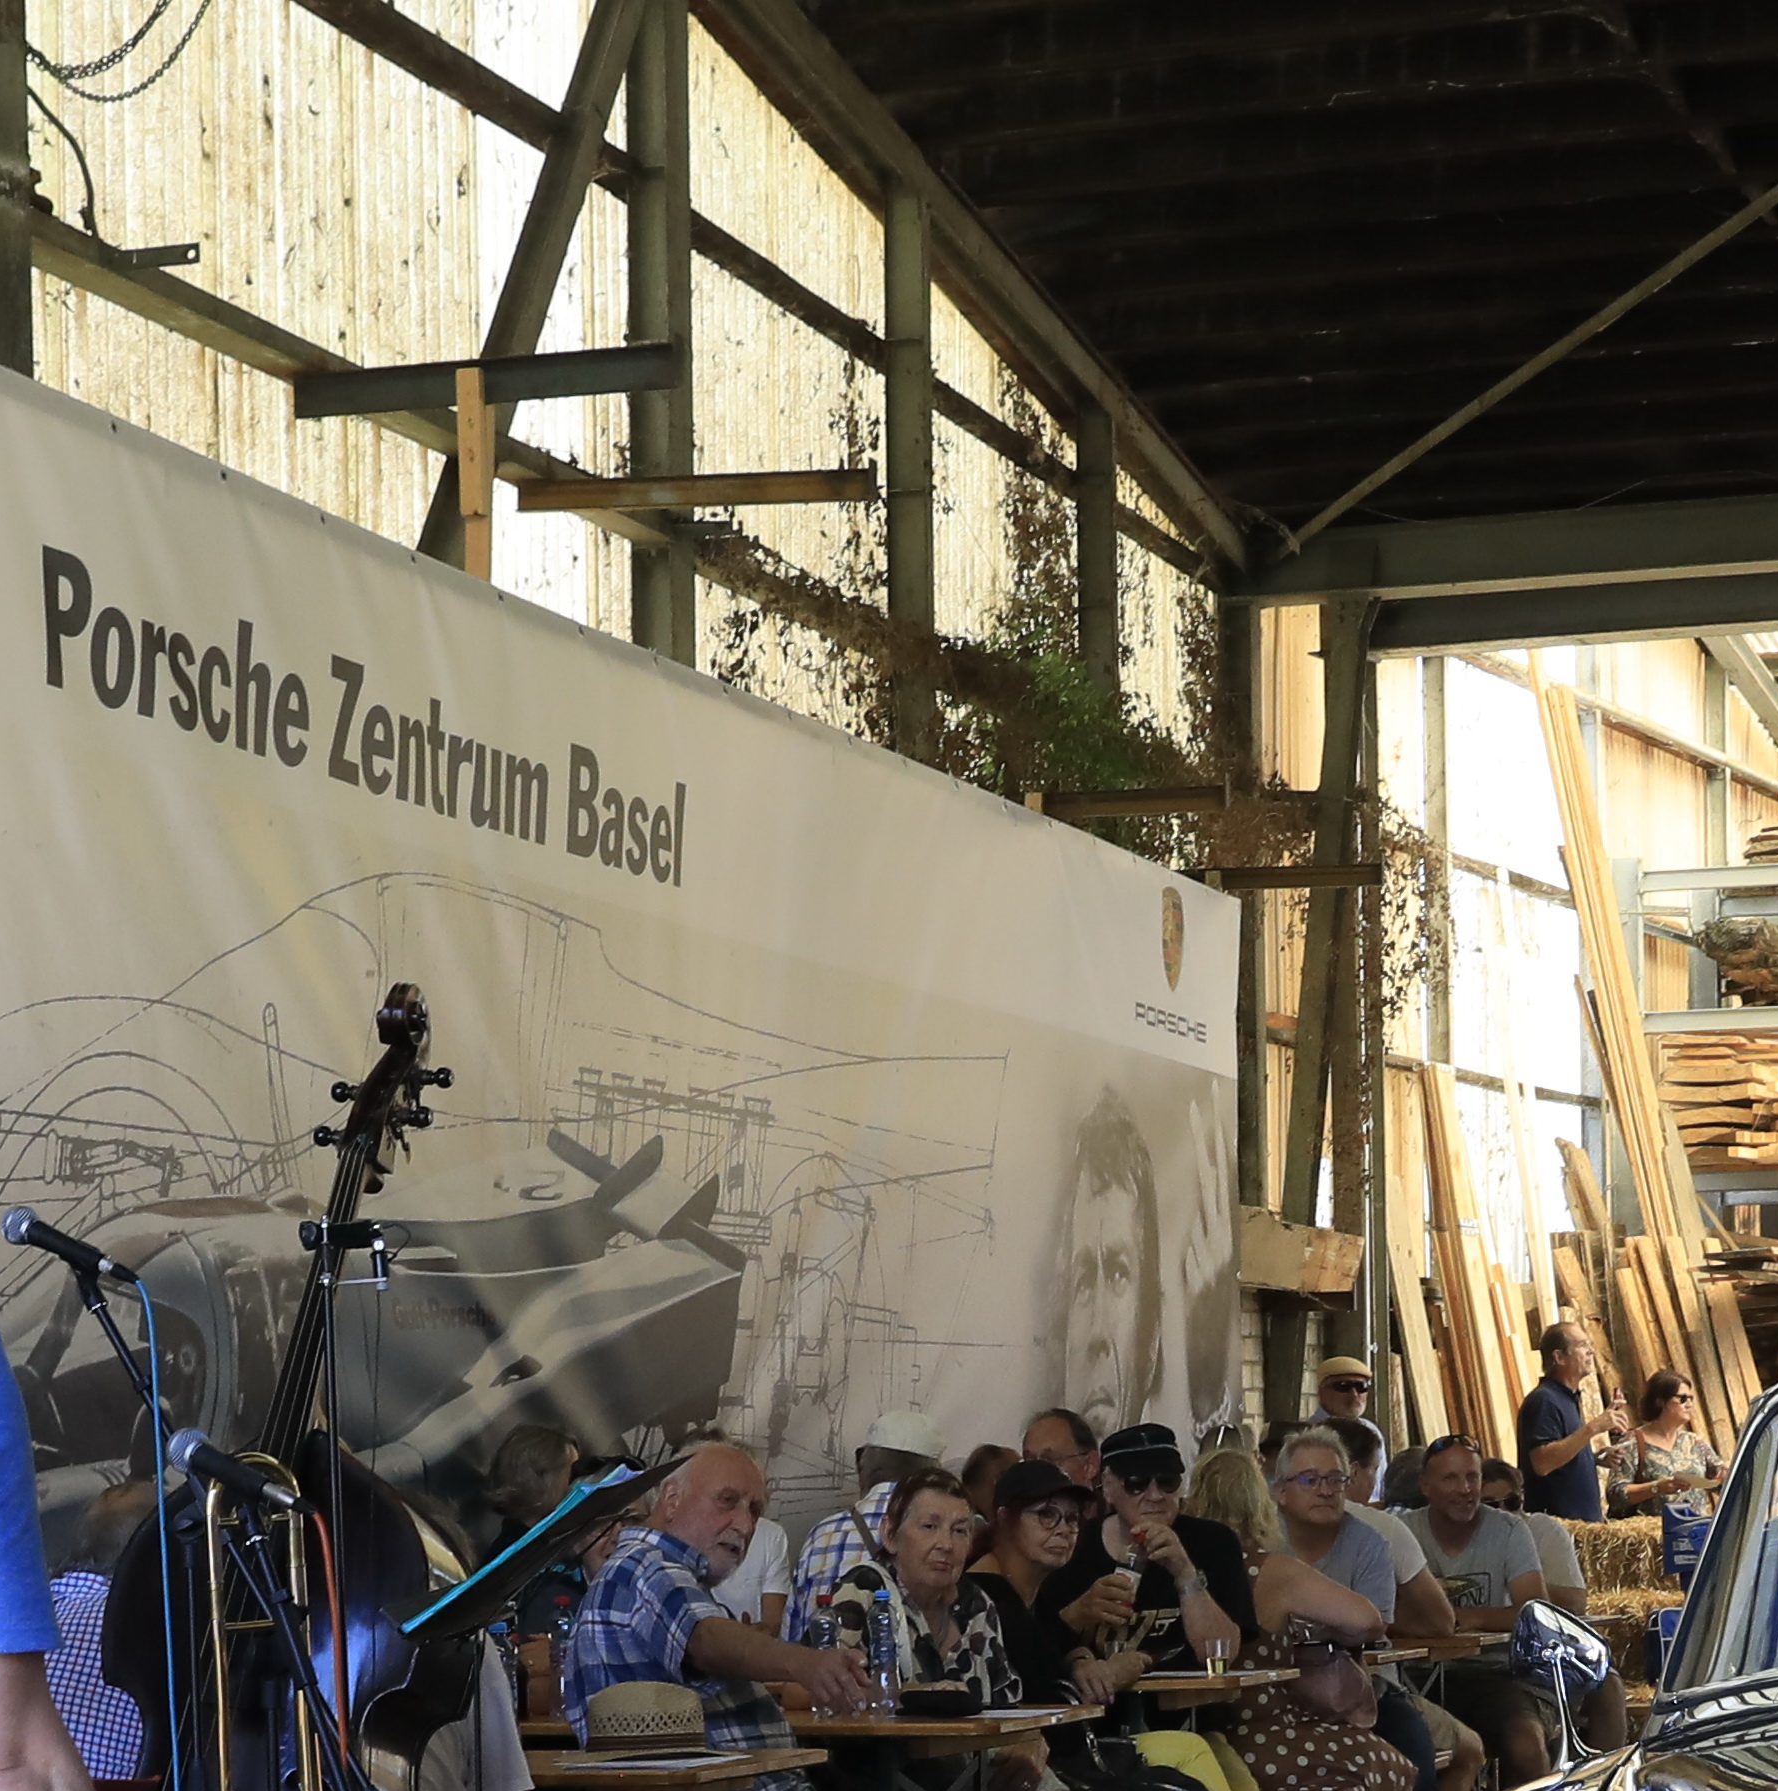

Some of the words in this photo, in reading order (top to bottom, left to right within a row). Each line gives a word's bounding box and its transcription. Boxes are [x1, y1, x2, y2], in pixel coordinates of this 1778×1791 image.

[41, 544, 311, 769] Porsche
[327, 654, 549, 846] Zentrum
[565, 742, 687, 889] Basel
[1134, 1001, 1208, 1044] PORSCHE
